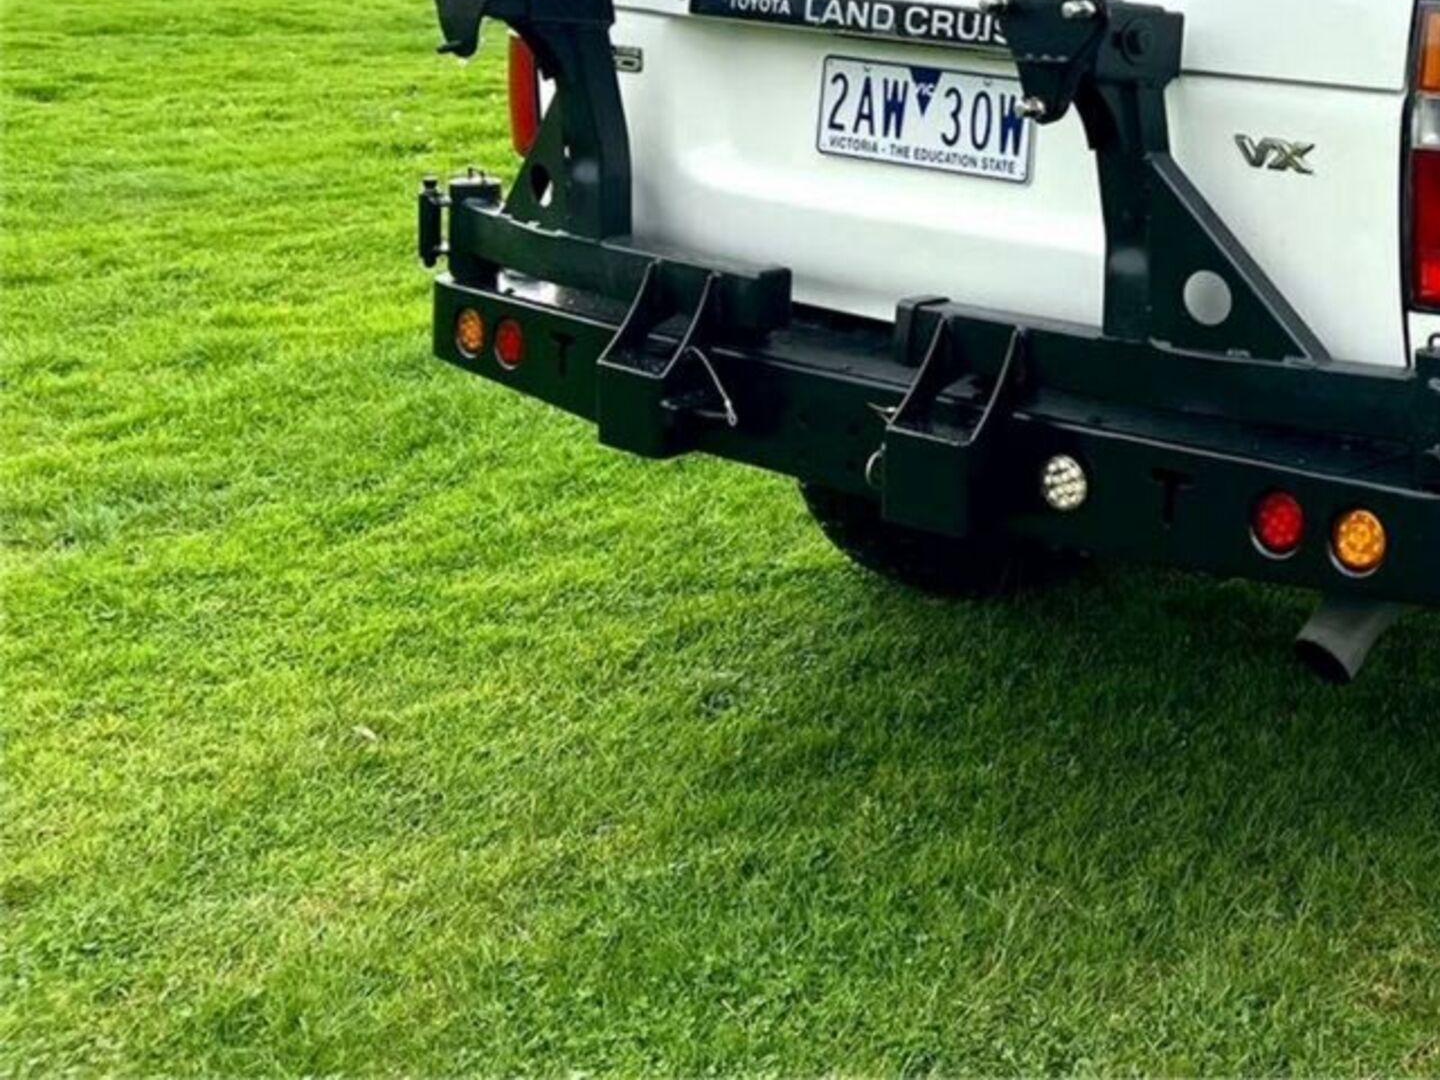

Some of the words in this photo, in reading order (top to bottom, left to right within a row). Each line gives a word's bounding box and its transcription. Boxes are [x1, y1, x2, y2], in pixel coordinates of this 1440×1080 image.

[904, 6, 1008, 45] CRUIS
[828, 72, 909, 139] 2AW
[941, 87, 1025, 156] 30W
[828, 135, 878, 154] VICTORIA
[890, 144, 910, 161] THE
[913, 148, 978, 169] EDUCATION
[981, 158, 1016, 175] STATE
[1234, 133, 1315, 175] VX
